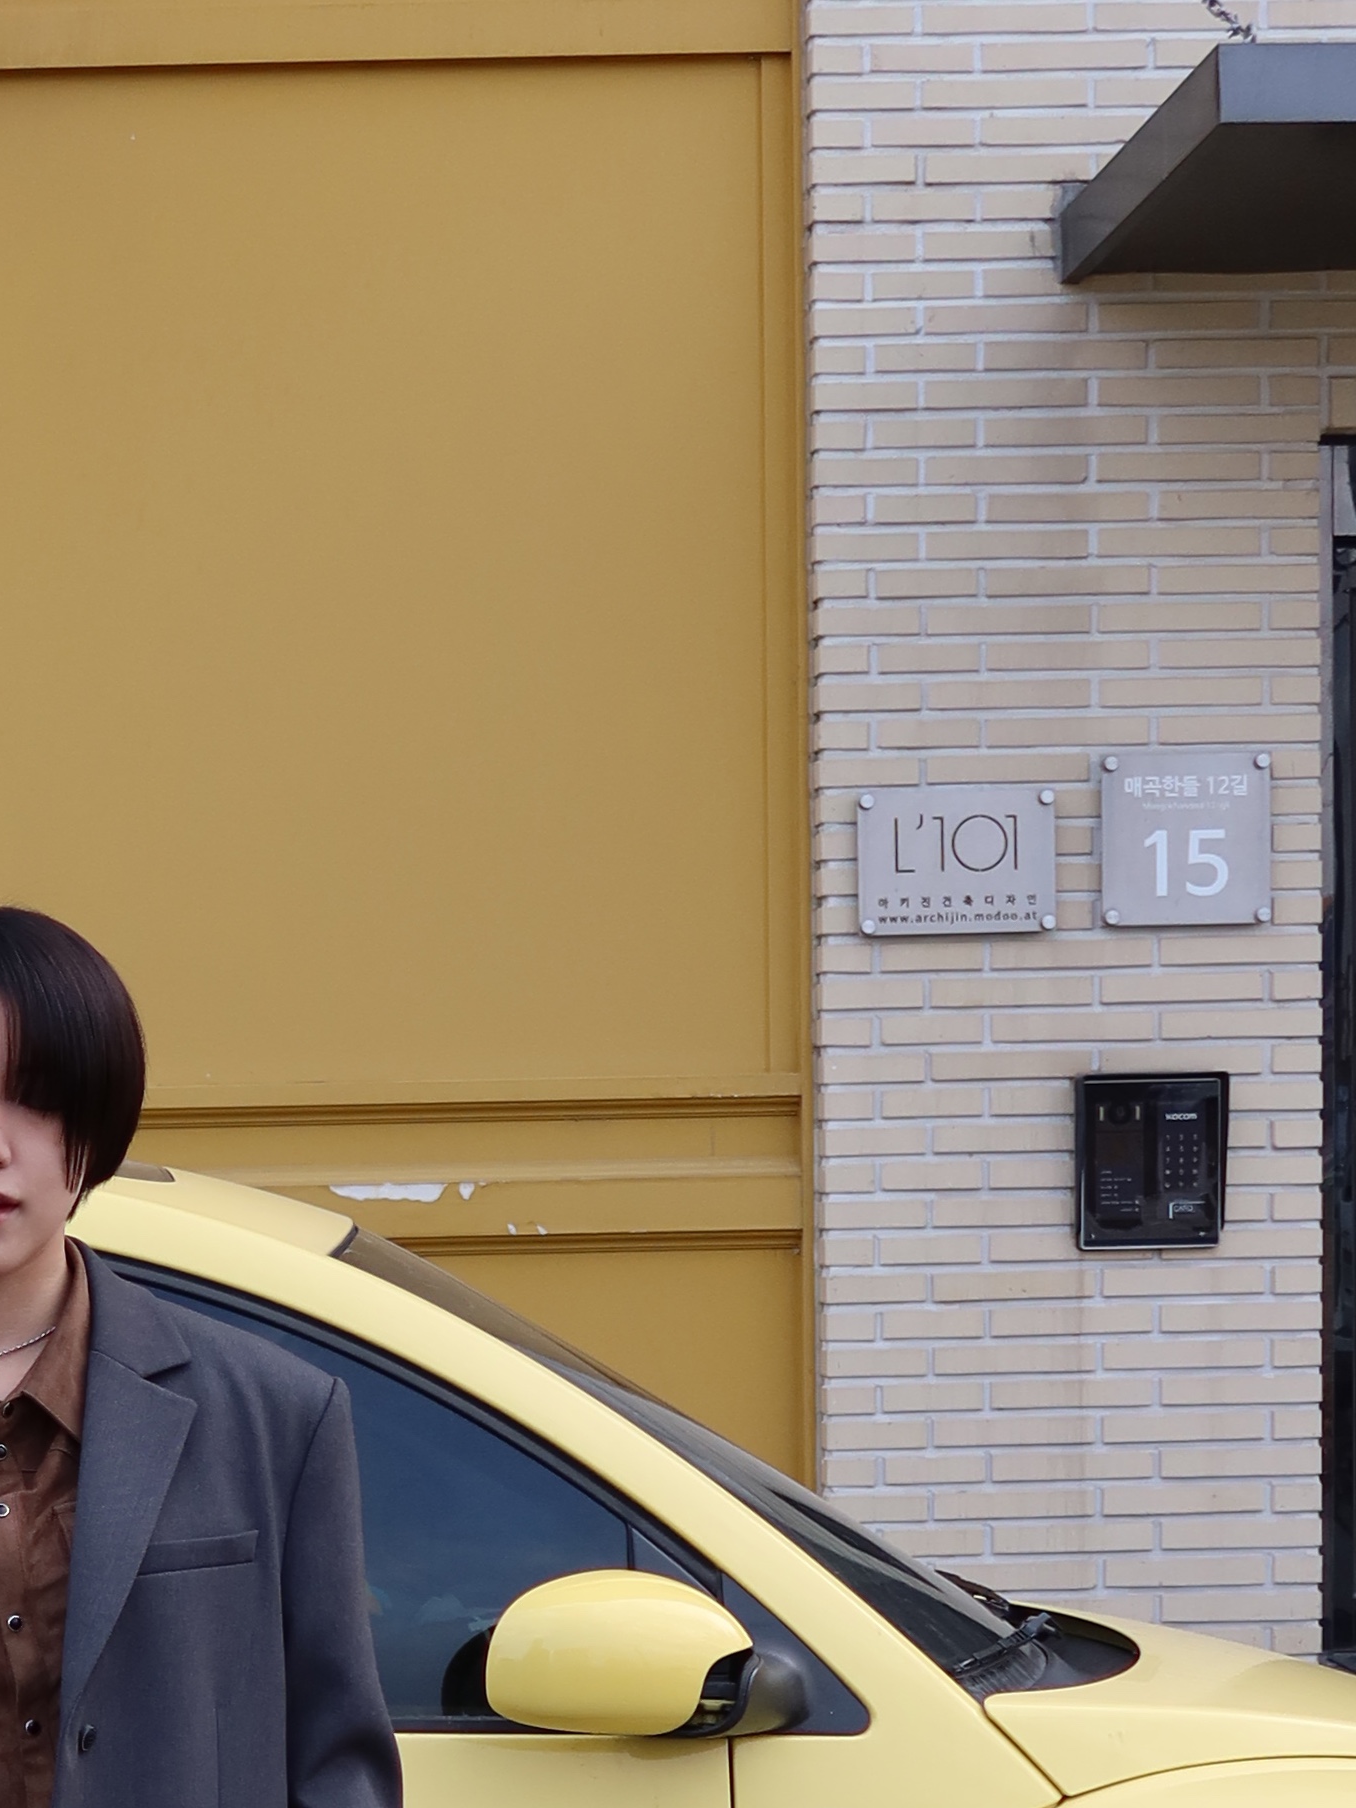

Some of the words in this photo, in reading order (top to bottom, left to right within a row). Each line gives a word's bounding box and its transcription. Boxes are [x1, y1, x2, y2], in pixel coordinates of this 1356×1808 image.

[1124, 775, 1200, 797] 매곡한들
[1207, 774, 1248, 796] 12길
[1144, 828, 1229, 897] 15
[877, 911, 1038, 925] www.archijin.modoo.at
